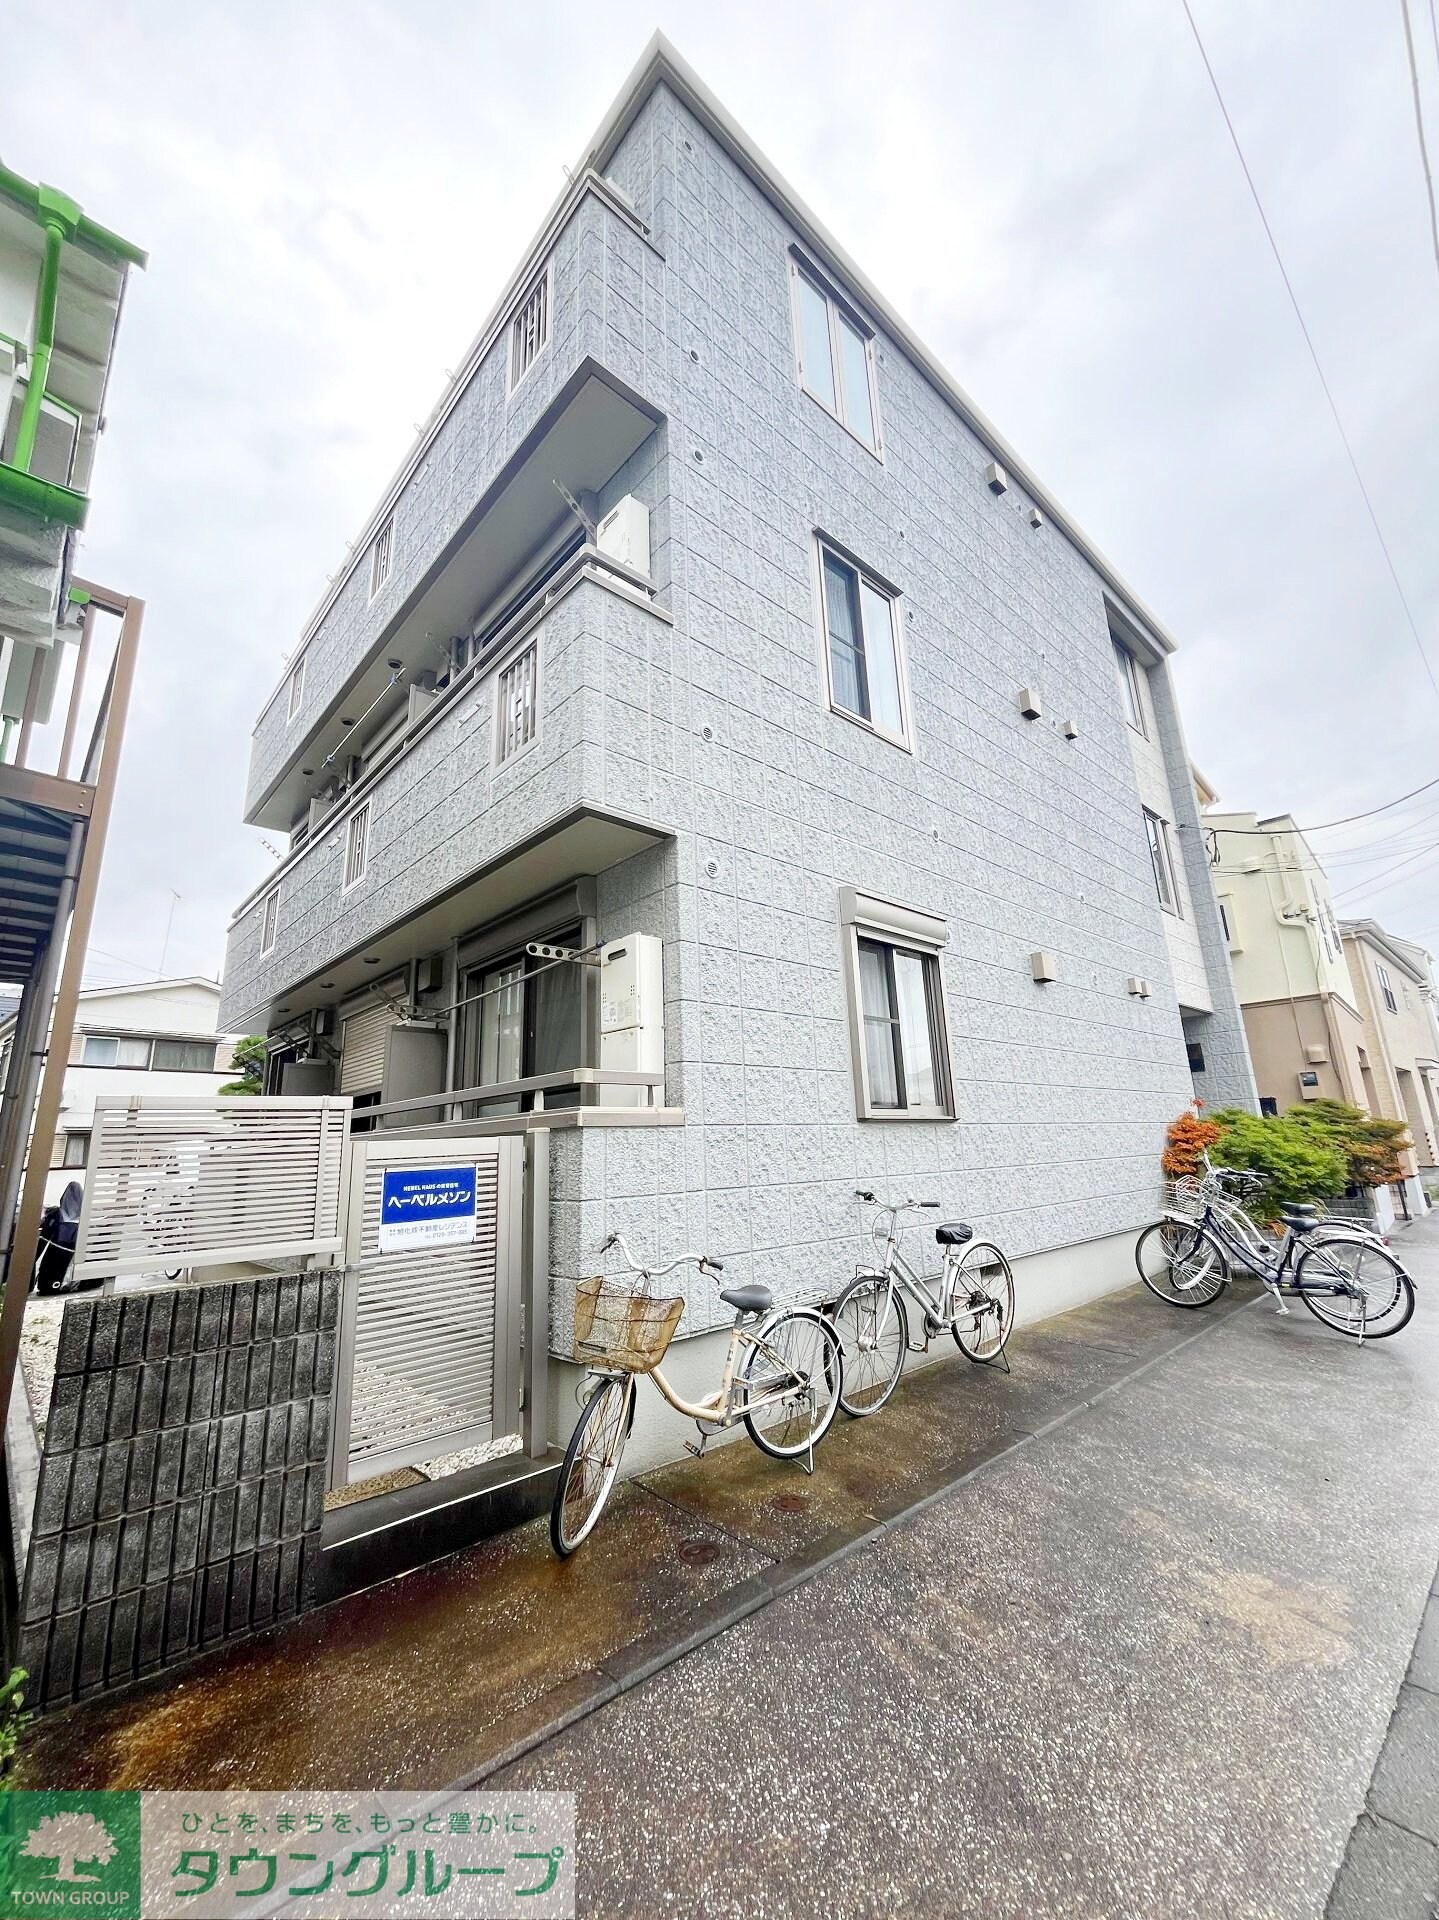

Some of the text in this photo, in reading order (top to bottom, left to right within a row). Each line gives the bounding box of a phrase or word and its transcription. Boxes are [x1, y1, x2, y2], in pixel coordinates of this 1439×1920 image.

[388, 1191, 471, 1209] ヘーベルメゾン
